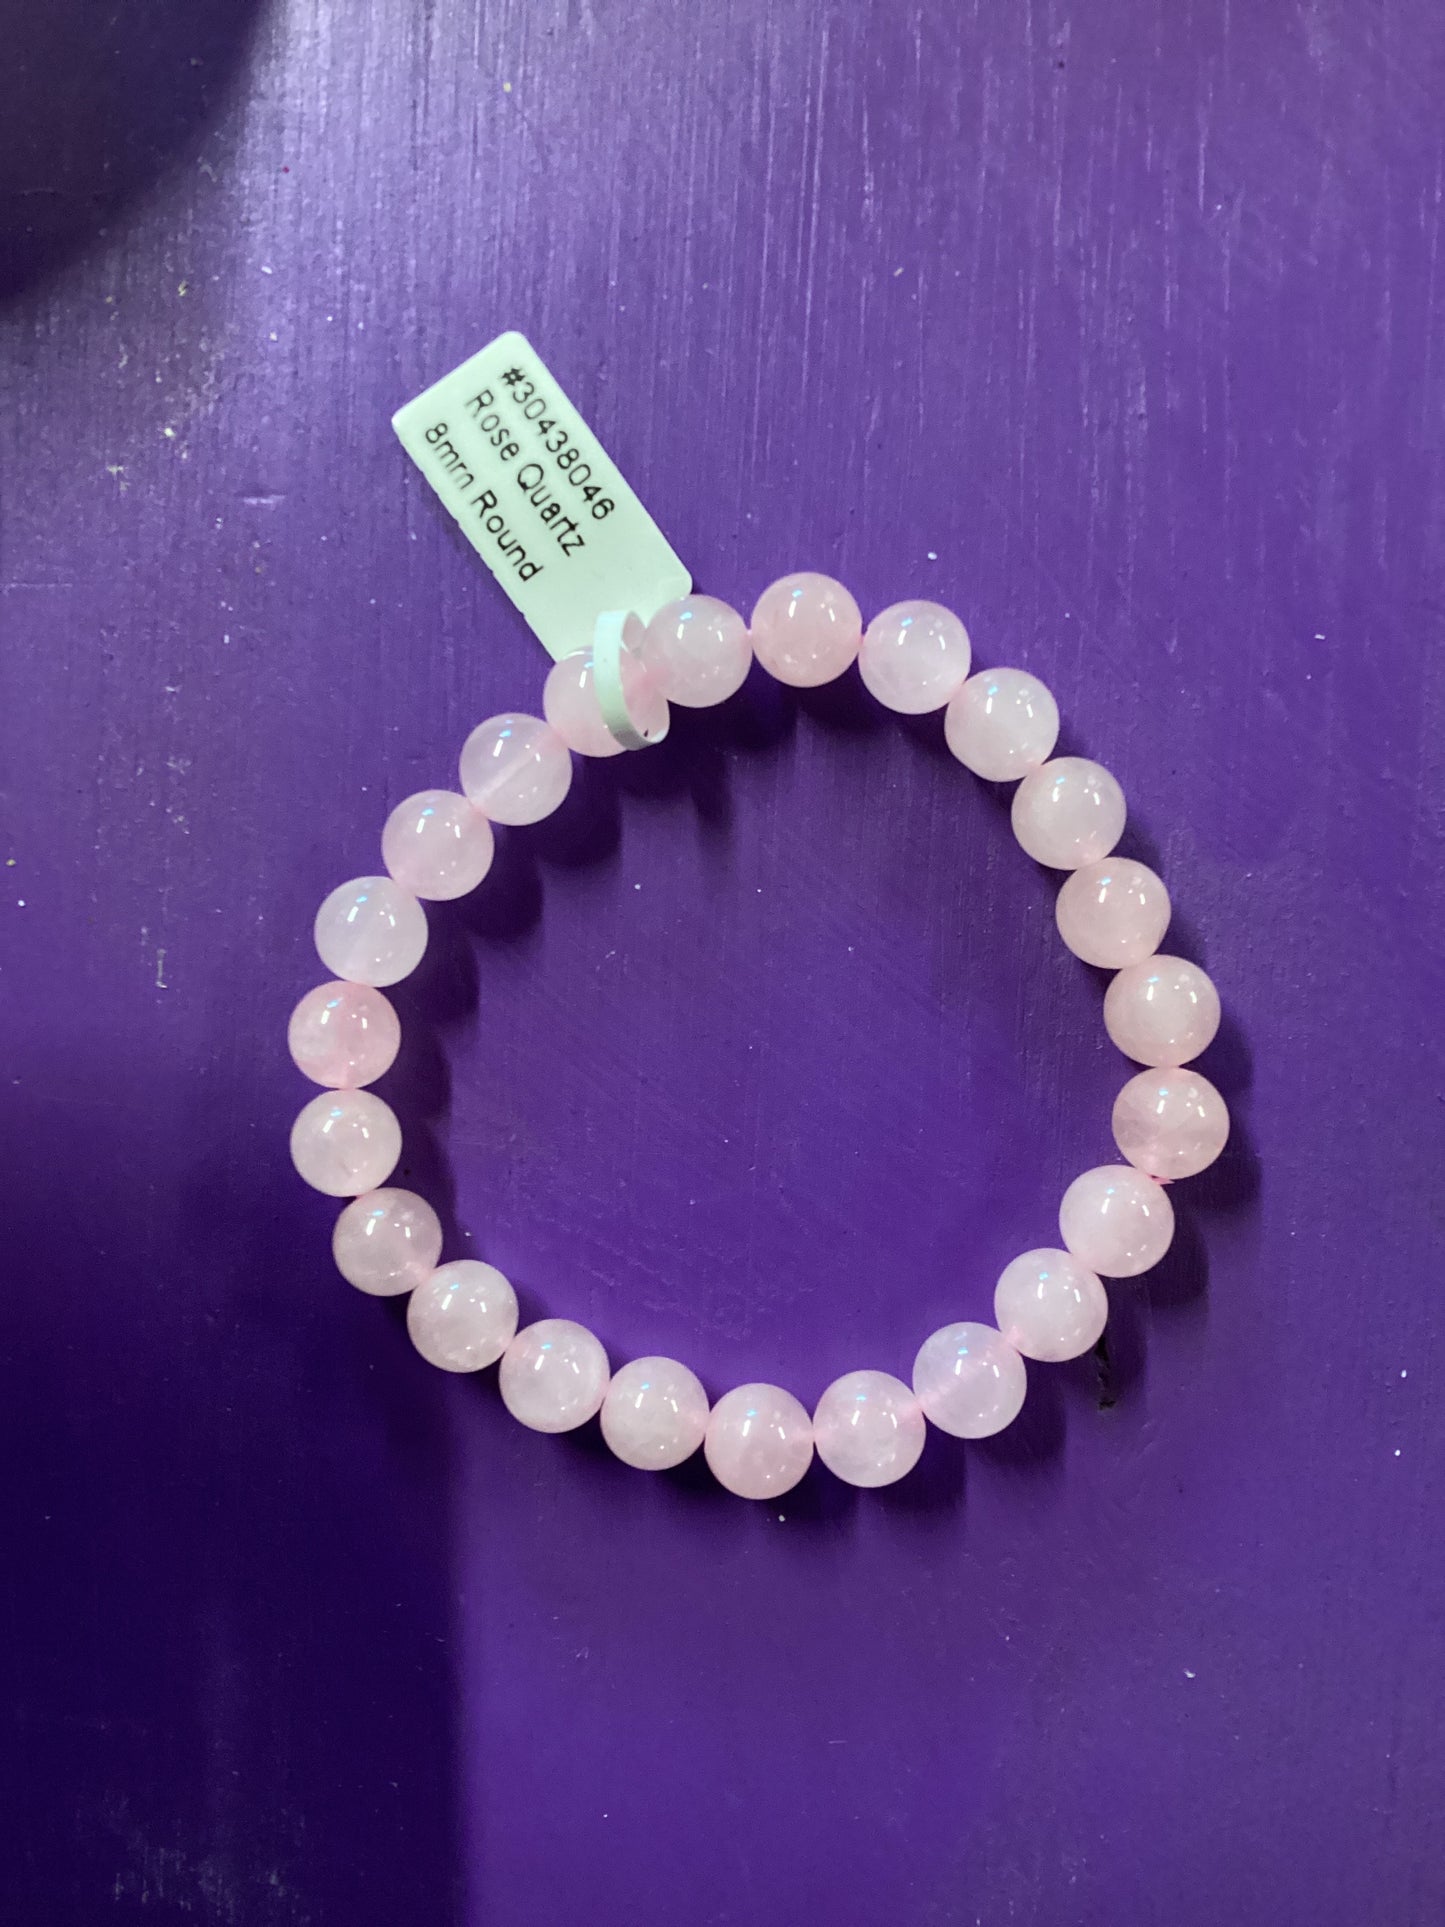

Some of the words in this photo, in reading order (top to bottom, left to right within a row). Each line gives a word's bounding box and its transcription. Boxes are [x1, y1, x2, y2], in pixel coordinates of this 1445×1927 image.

[425, 422, 474, 490] 8mm
[471, 490, 543, 581] Round
[465, 389, 520, 461] Rose
[517, 463, 585, 557] Quartz
[500, 367, 615, 520] #30438046
